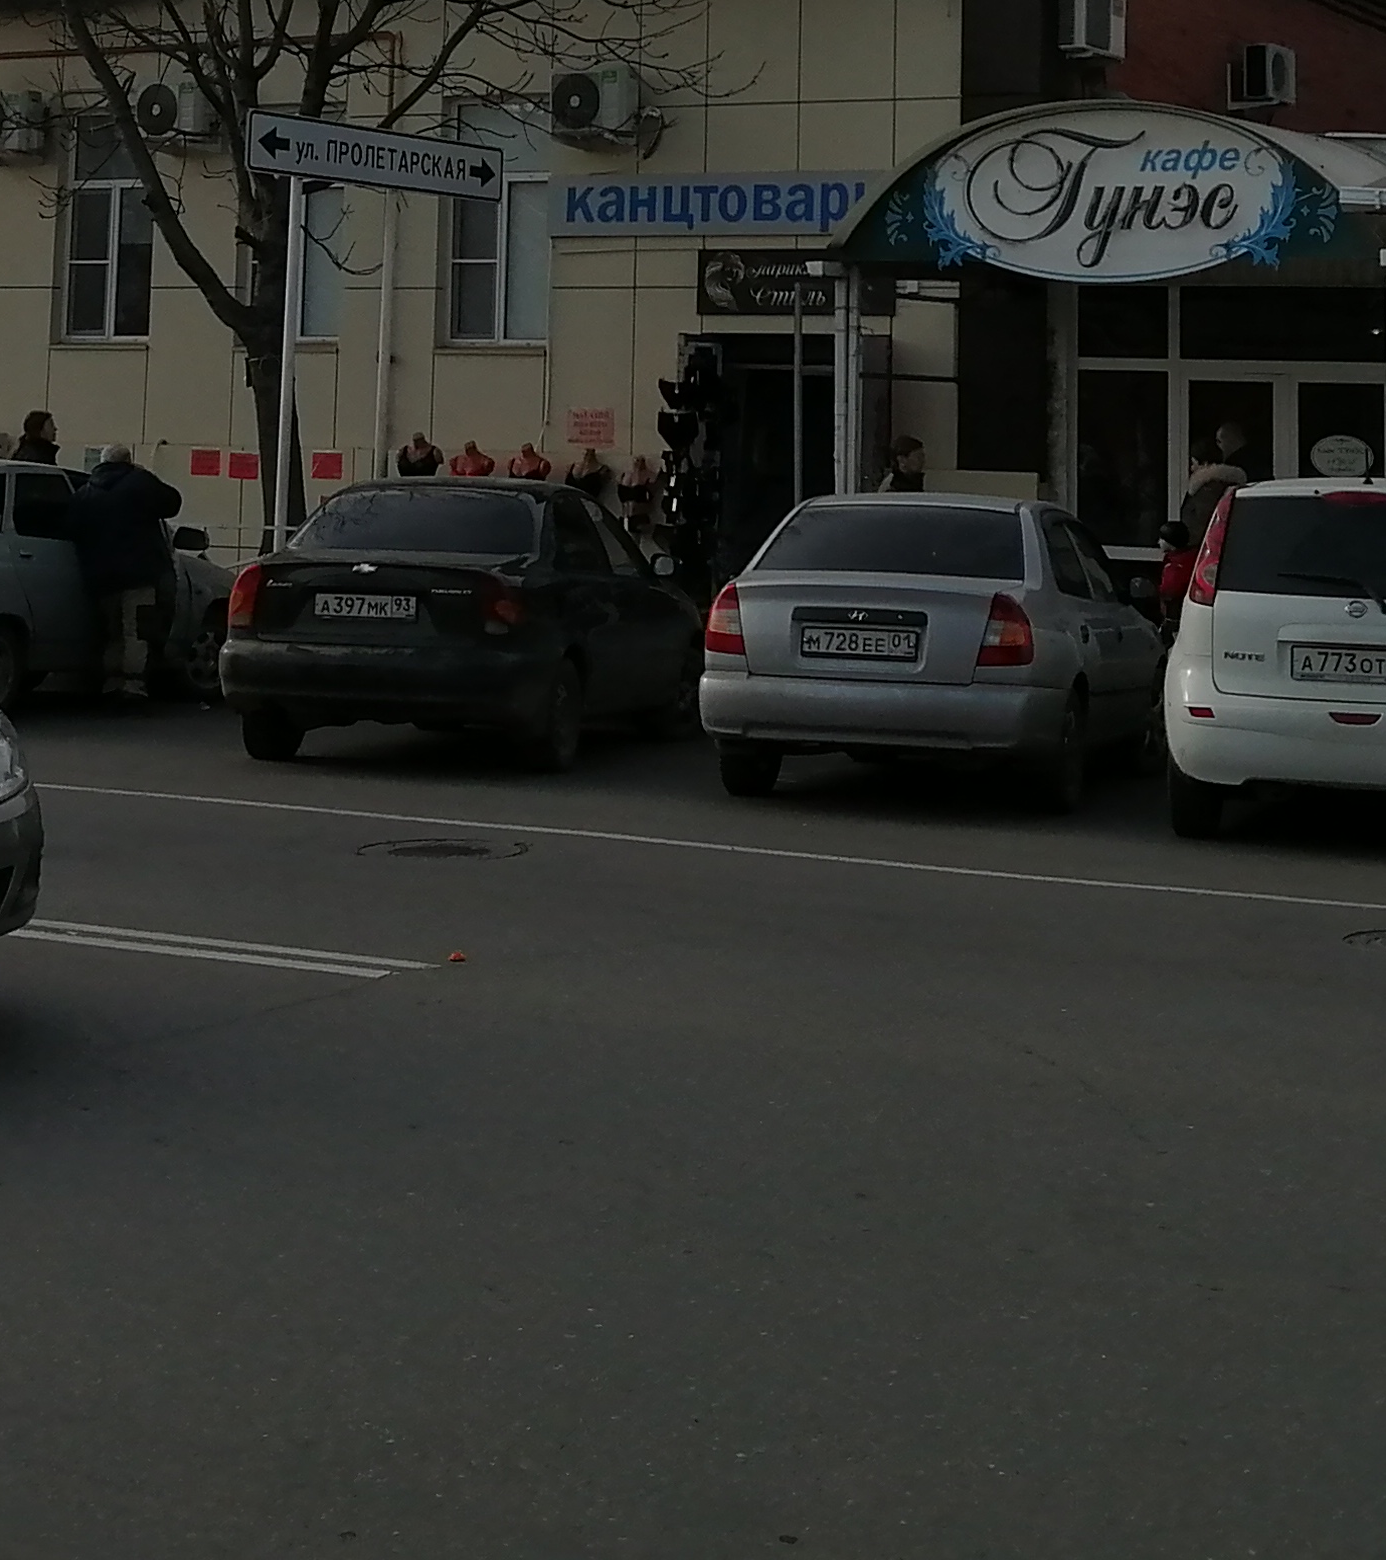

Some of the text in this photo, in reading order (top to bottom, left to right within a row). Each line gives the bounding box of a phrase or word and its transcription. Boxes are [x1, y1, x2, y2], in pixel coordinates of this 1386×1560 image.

[295, 139, 467, 182] ул. ПРОЛЕТАРСКАЯ
[1139, 139, 1241, 179] кафе
[394, 597, 411, 612] 93
